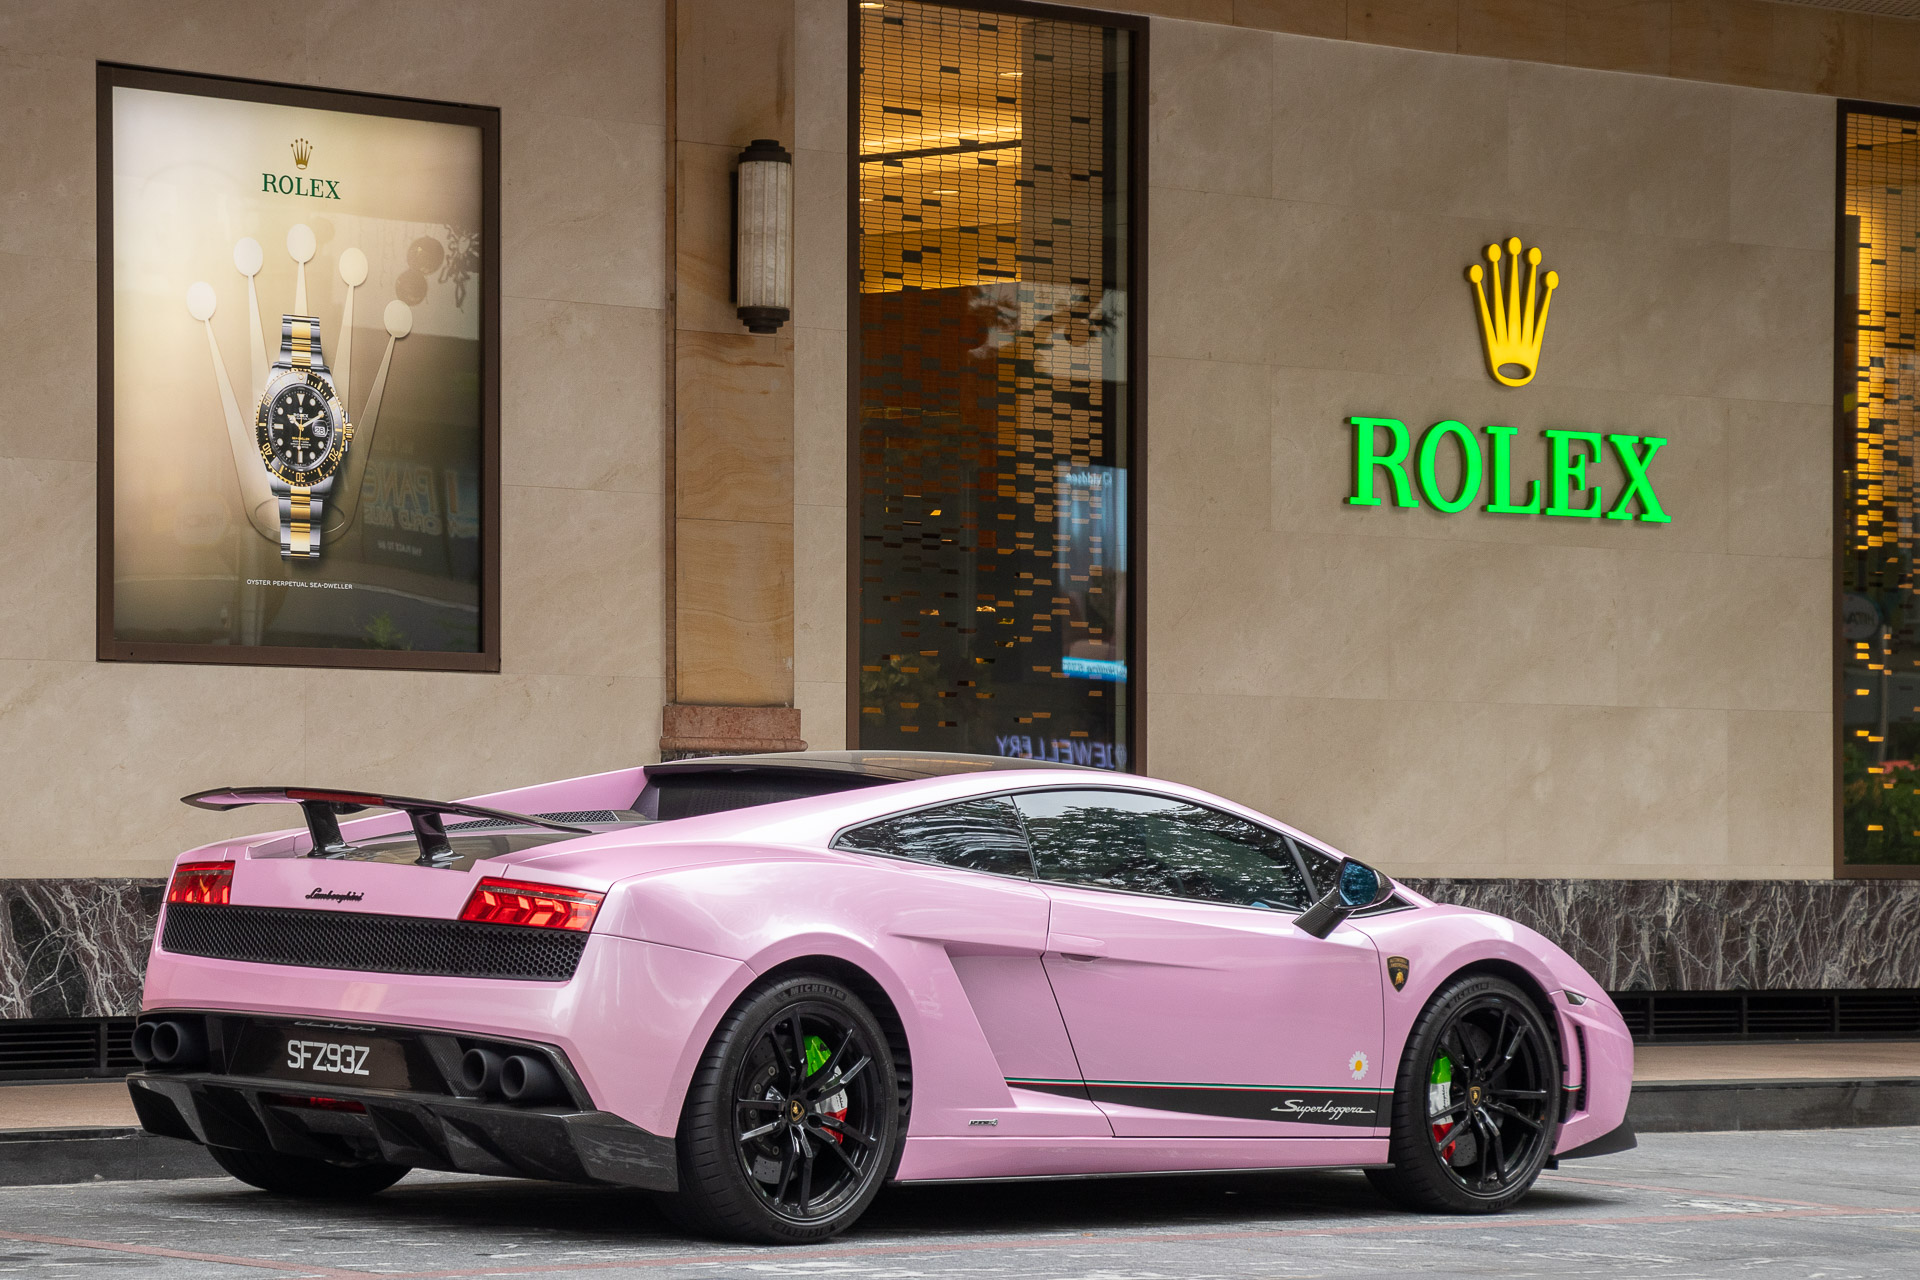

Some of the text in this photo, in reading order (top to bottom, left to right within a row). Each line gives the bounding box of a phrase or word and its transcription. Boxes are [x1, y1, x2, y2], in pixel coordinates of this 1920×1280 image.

[261, 173, 341, 200] ROLEX
[1347, 415, 1672, 524] ROLEX
[246, 578, 353, 590] OYSTER PERPETUAL SEA-DWELLER
[789, 983, 846, 1000] MICHELIN
[287, 1039, 370, 1076] SFZ93Z
[1270, 1099, 1376, 1121] Superleggera
